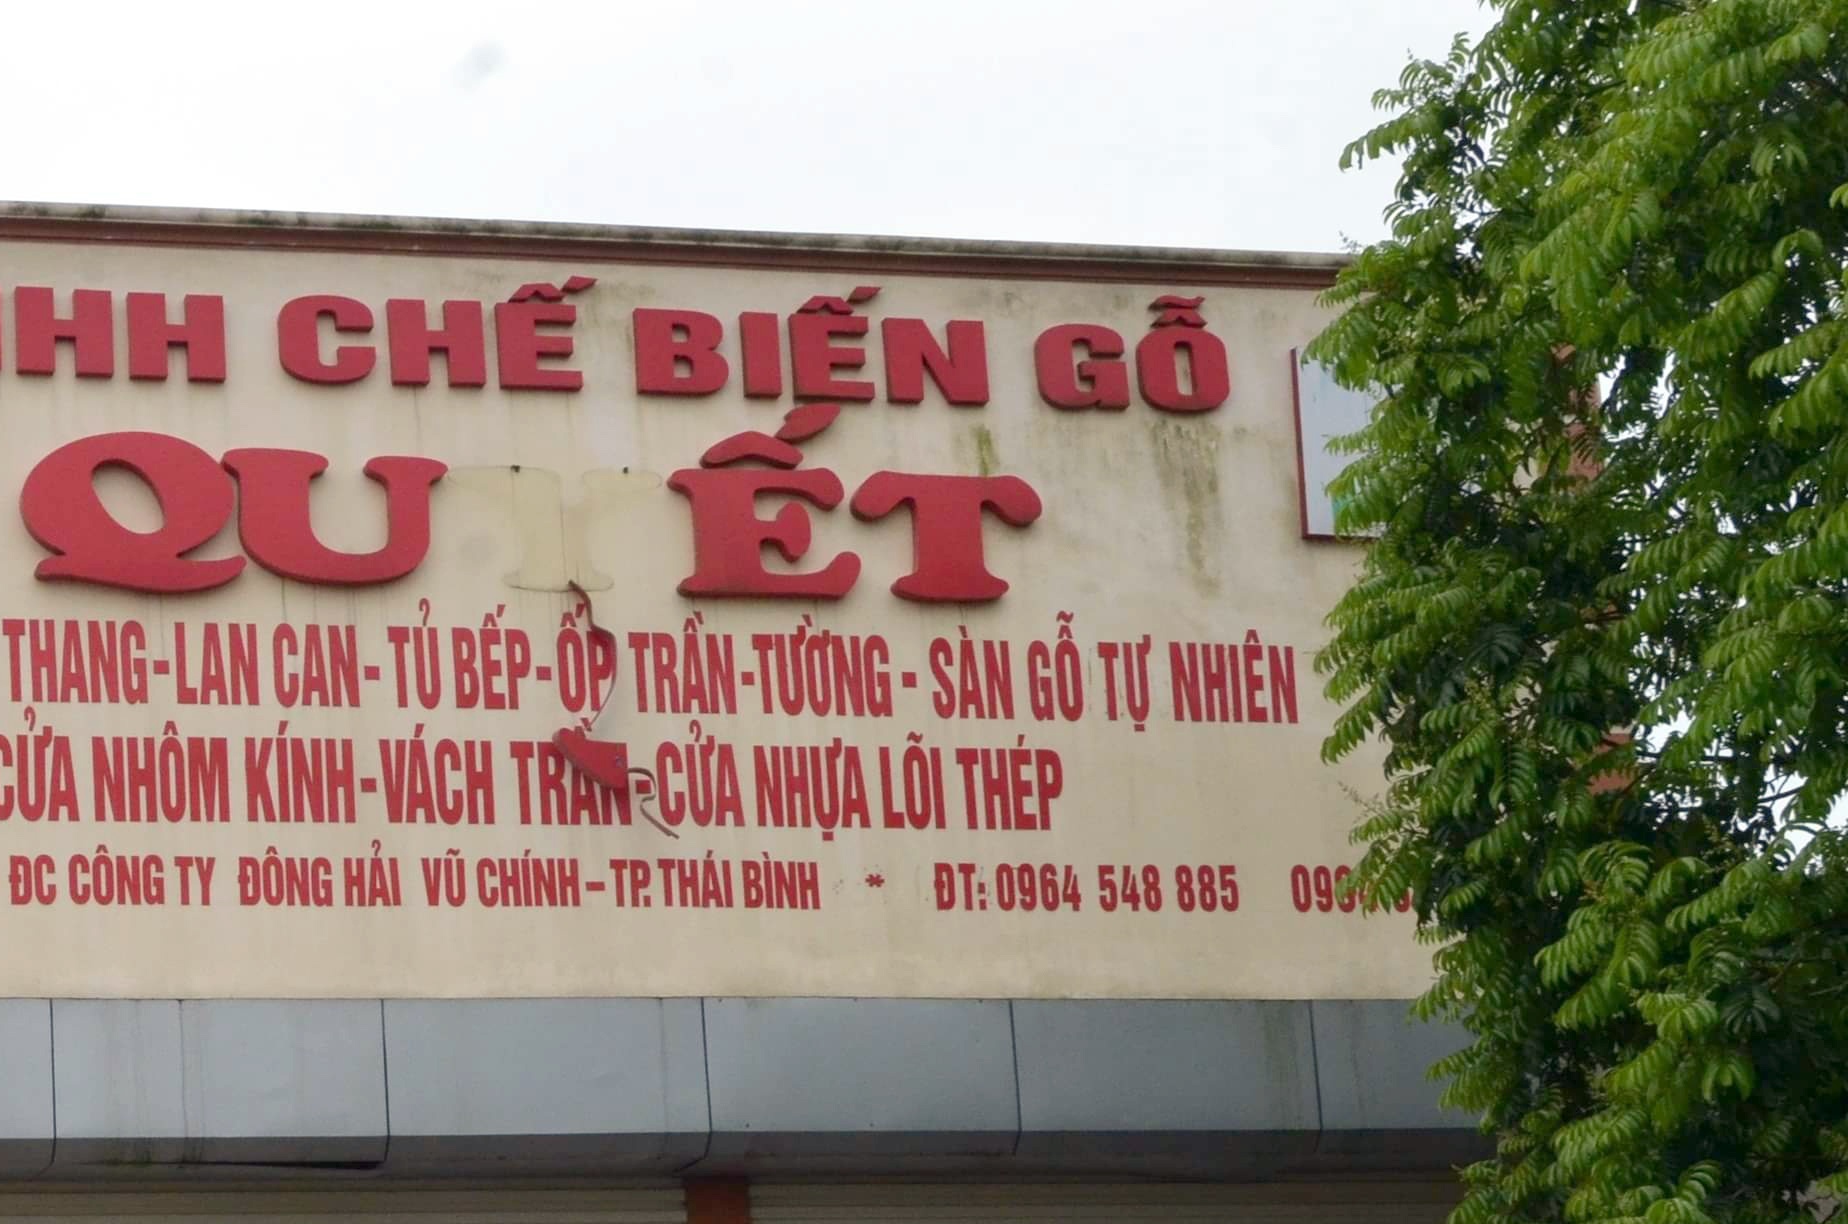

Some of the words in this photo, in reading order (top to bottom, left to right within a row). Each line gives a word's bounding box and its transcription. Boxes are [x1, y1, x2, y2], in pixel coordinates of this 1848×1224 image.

[277, 275, 594, 391] CHẾ
[632, 287, 990, 404] BIẾN
[1036, 295, 1231, 409] GỖ
[930, 628, 1015, 720] SÀN
[1028, 611, 1085, 720] GỖ
[1098, 636, 1152, 731] TỰ
[1169, 630, 1298, 723] NHIÊN
[92, 720, 231, 823] NHÔM
[753, 737, 872, 841] NHỰA
[879, 732, 947, 831] LÕI
[956, 736, 1063, 831] THÉP
[9, 855, 57, 906] ĐC
[68, 844, 166, 905] CÔNG
[174, 855, 216, 906] TY
[238, 847, 334, 907] ĐÔNG
[343, 840, 402, 907] HẢI
[422, 848, 467, 907] VŨ
[742, 852, 821, 910] BÌNH
[935, 863, 988, 911] ĐT:
[996, 864, 1081, 911] 0964
[1098, 864, 1164, 912] 548
[1176, 864, 1240, 912] 885
